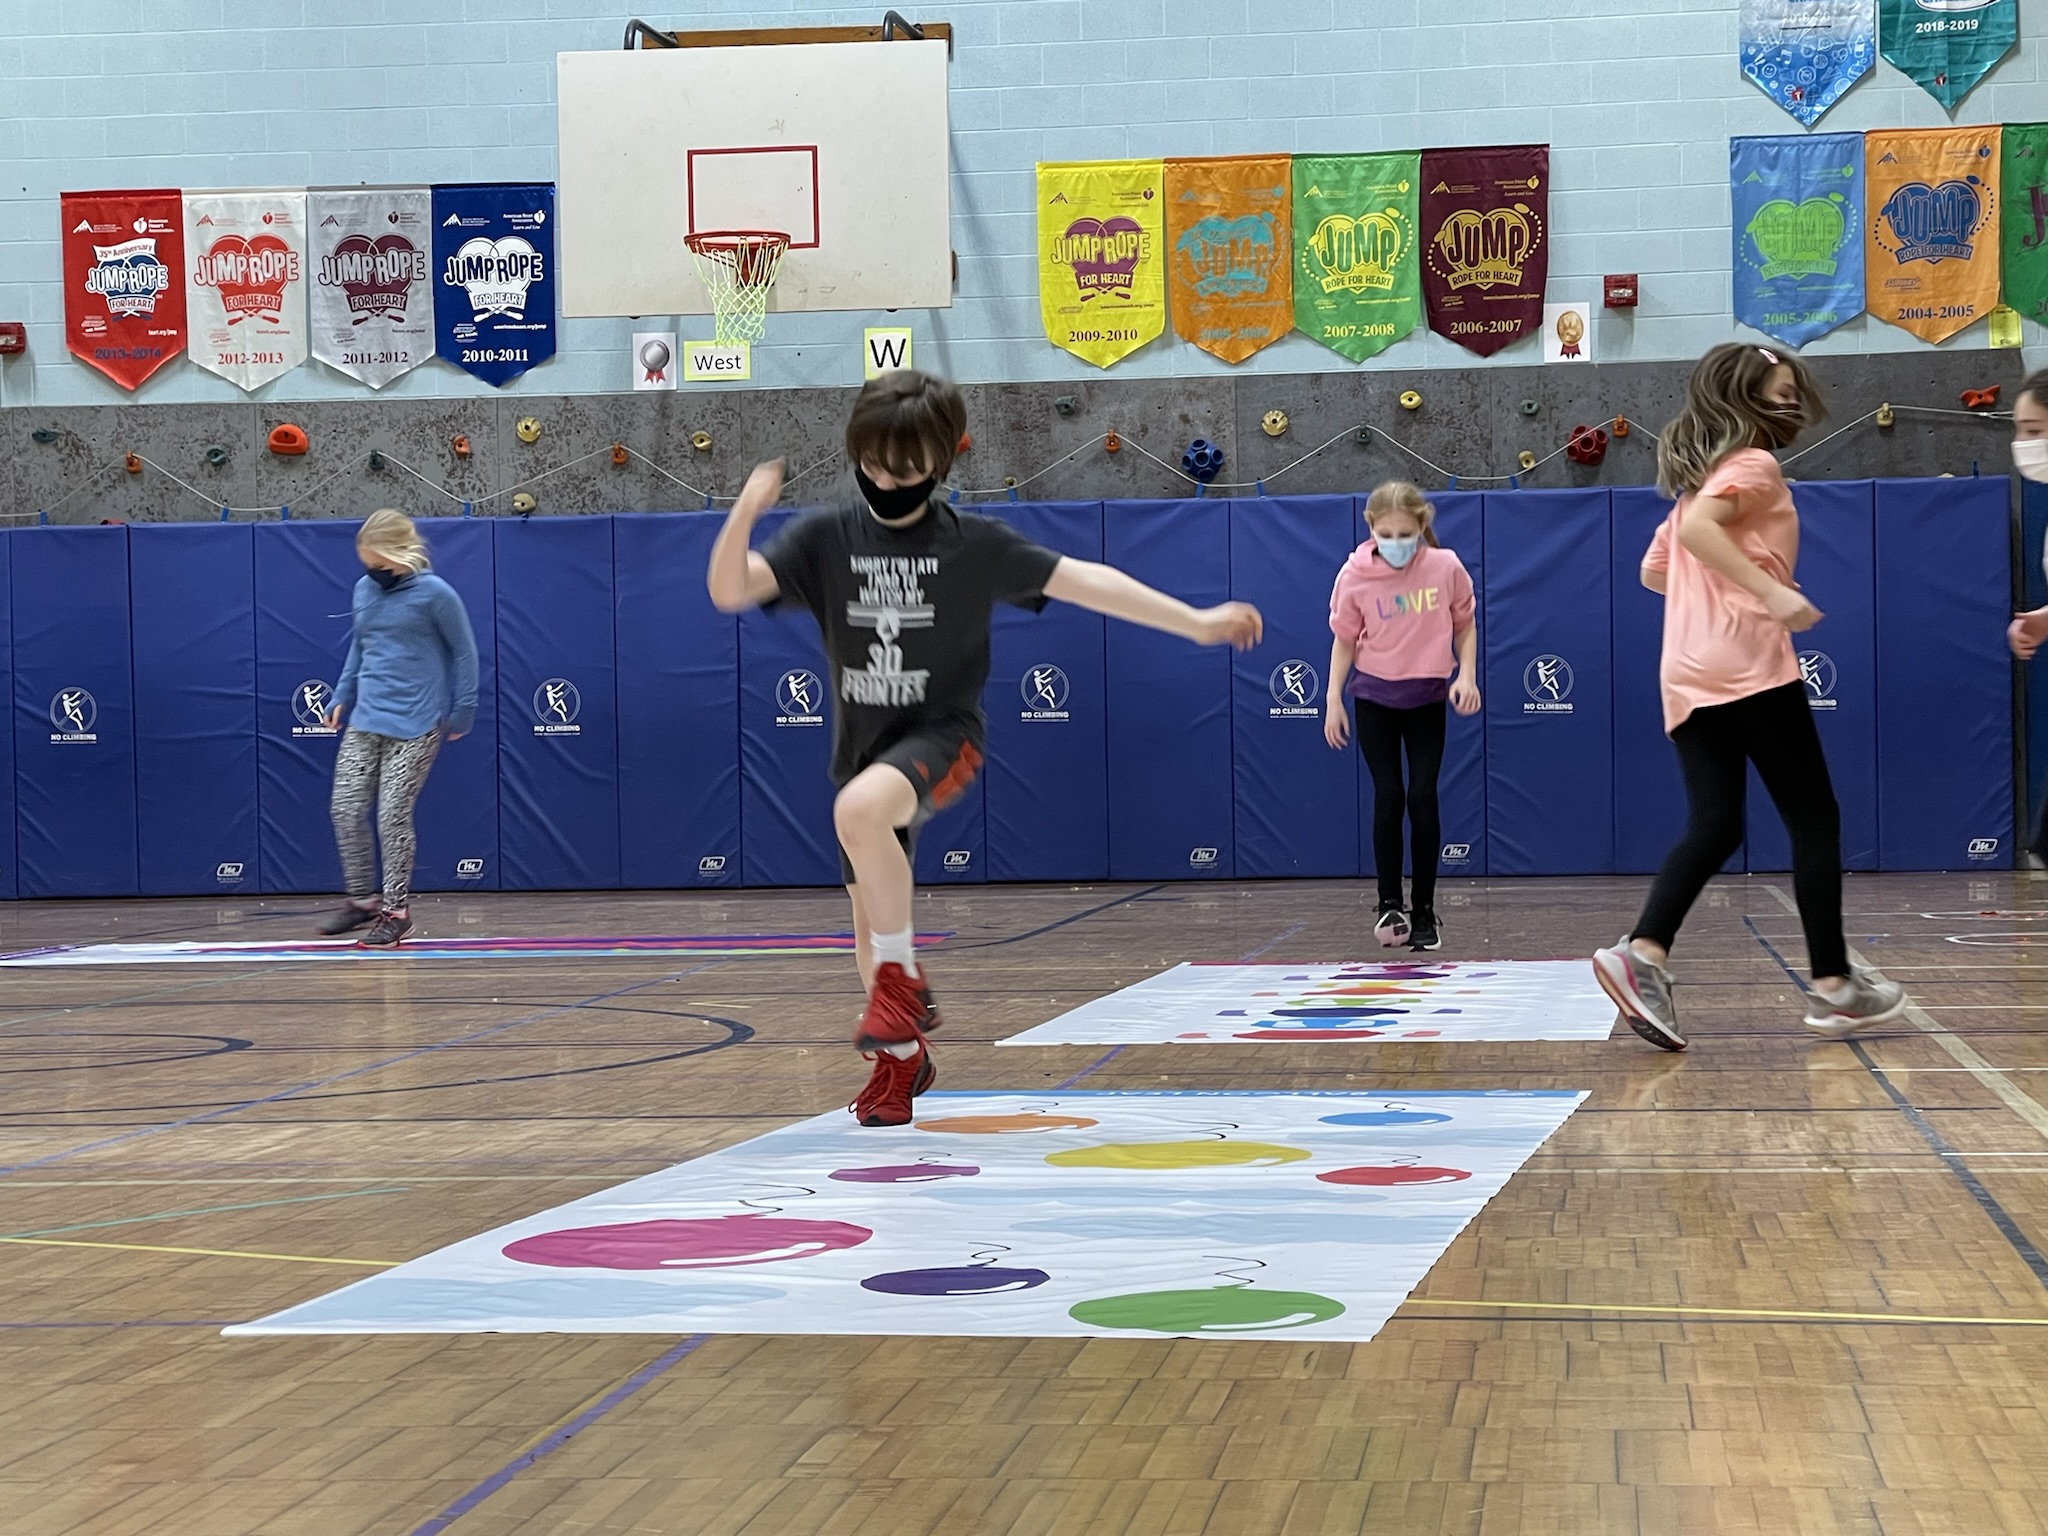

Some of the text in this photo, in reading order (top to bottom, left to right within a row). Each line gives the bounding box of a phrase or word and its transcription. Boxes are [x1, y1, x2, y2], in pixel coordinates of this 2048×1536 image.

[1915, 19, 1979, 34] 2018-2019
[1894, 187, 1977, 245] JUMP
[1758, 204, 1840, 261] JUMP
[113, 244, 153, 257] Anniversary
[1320, 220, 1397, 274] JUMP
[1447, 216, 1525, 270] JUMP
[1900, 245, 1969, 260] ROPE FOR HEART
[1080, 273, 1131, 286] FOR HEART
[1325, 275, 1391, 289] ROPE FOR HEART
[1452, 270, 1519, 286] ROPE FOR HEART
[112, 298, 152, 308] FOR HEART
[227, 295, 279, 309] FOR HEART
[352, 294, 404, 308] FOR HEART
[474, 292, 524, 307] FOR HEART
[1898, 304, 1974, 320] 2004-2005
[1323, 323, 1395, 338] 2007-2008
[1450, 319, 1522, 335] 2006-2007
[1069, 329, 1138, 342] 2009-2010
[218, 352, 283, 364] 2012-2013
[342, 351, 408, 364] 2011-2012
[462, 348, 529, 362] 2010-2011
[869, 338, 907, 369] W
[694, 354, 742, 371] West
[1375, 587, 1440, 620] LOVE
[50, 733, 97, 741] NO CLIMBING
